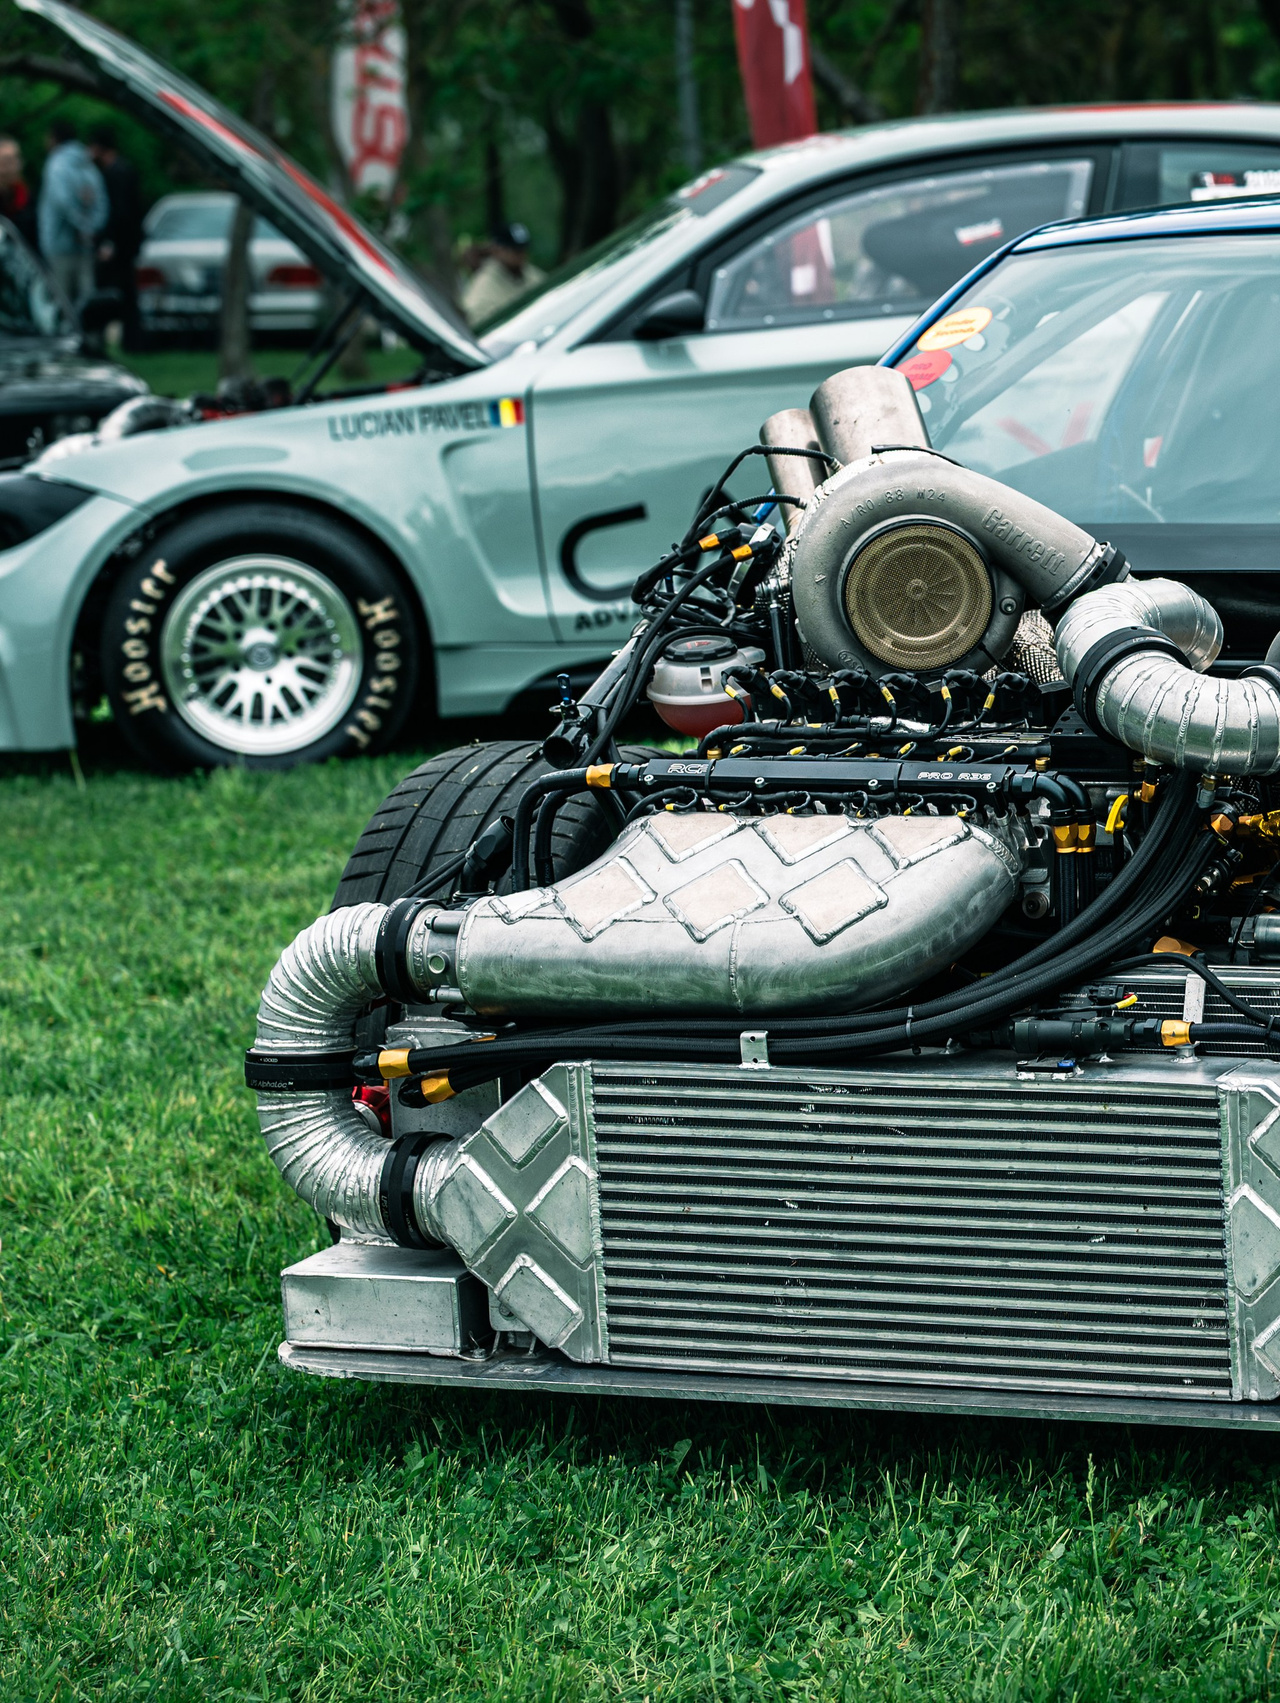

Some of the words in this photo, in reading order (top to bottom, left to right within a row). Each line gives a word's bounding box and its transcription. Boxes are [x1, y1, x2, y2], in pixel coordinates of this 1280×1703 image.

[327, 408, 415, 442] LUCIAN
[417, 401, 490, 434] PAVEL
[982, 505, 1067, 577] Garrett
[917, 771, 954, 781] PRO
